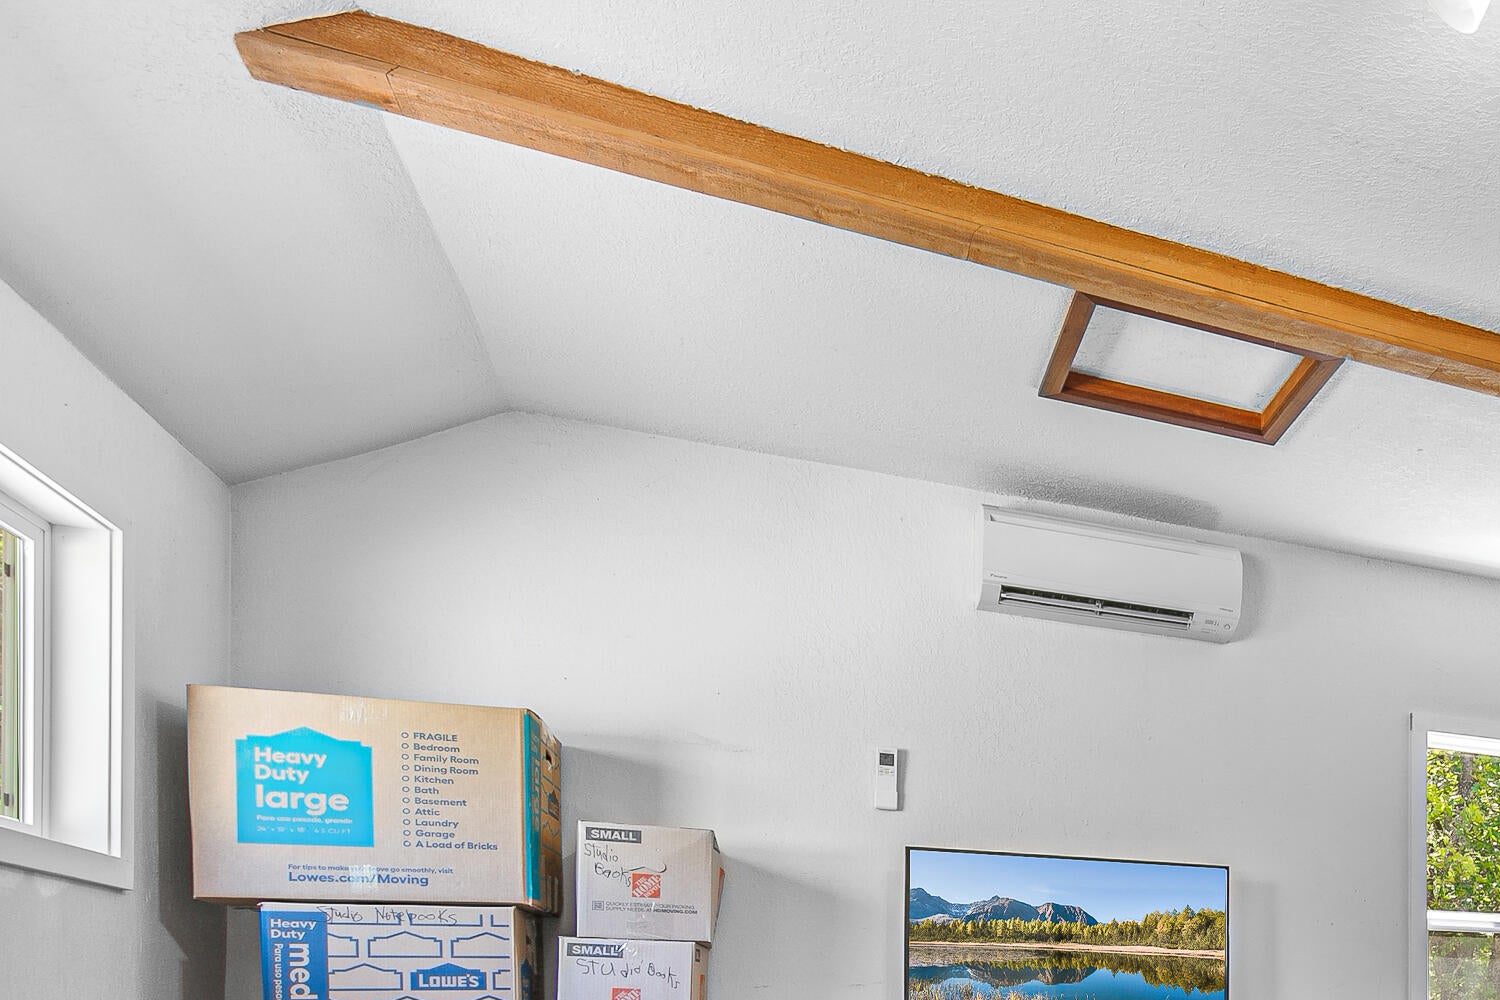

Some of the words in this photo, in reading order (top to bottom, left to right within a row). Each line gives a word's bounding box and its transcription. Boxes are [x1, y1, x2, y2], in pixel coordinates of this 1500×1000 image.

[413, 732, 458, 742] FRAGILE
[413, 743, 460, 753] Bedroom
[254, 746, 327, 768] Heavy
[413, 753, 448, 764] Family
[450, 755, 479, 765] Room
[254, 764, 309, 784] Duty
[414, 764, 447, 775] Dining
[449, 766, 479, 775] Room
[414, 775, 454, 785] Kitchen
[414, 786, 439, 795] Bath
[255, 784, 349, 816] large
[414, 797, 467, 807] Basement
[415, 808, 440, 816] Attic
[415, 819, 459, 829] Laundry
[415, 829, 455, 839] Garage
[590, 829, 637, 841] SMALL
[416, 840, 424, 848] A
[426, 841, 452, 849] Load
[454, 841, 465, 849] of
[467, 842, 498, 850] Bricks
[584, 842, 619, 862] Studio
[302, 864, 317, 872] tips
[288, 872, 429, 886] Lowes.com/Moving
[270, 918, 317, 930] Heavy
[270, 929, 306, 941] Duty
[274, 943, 284, 963] Para
[572, 944, 618, 956] SMALL
[274, 963, 283, 978] uso
[418, 973, 480, 988] LOWE'S
